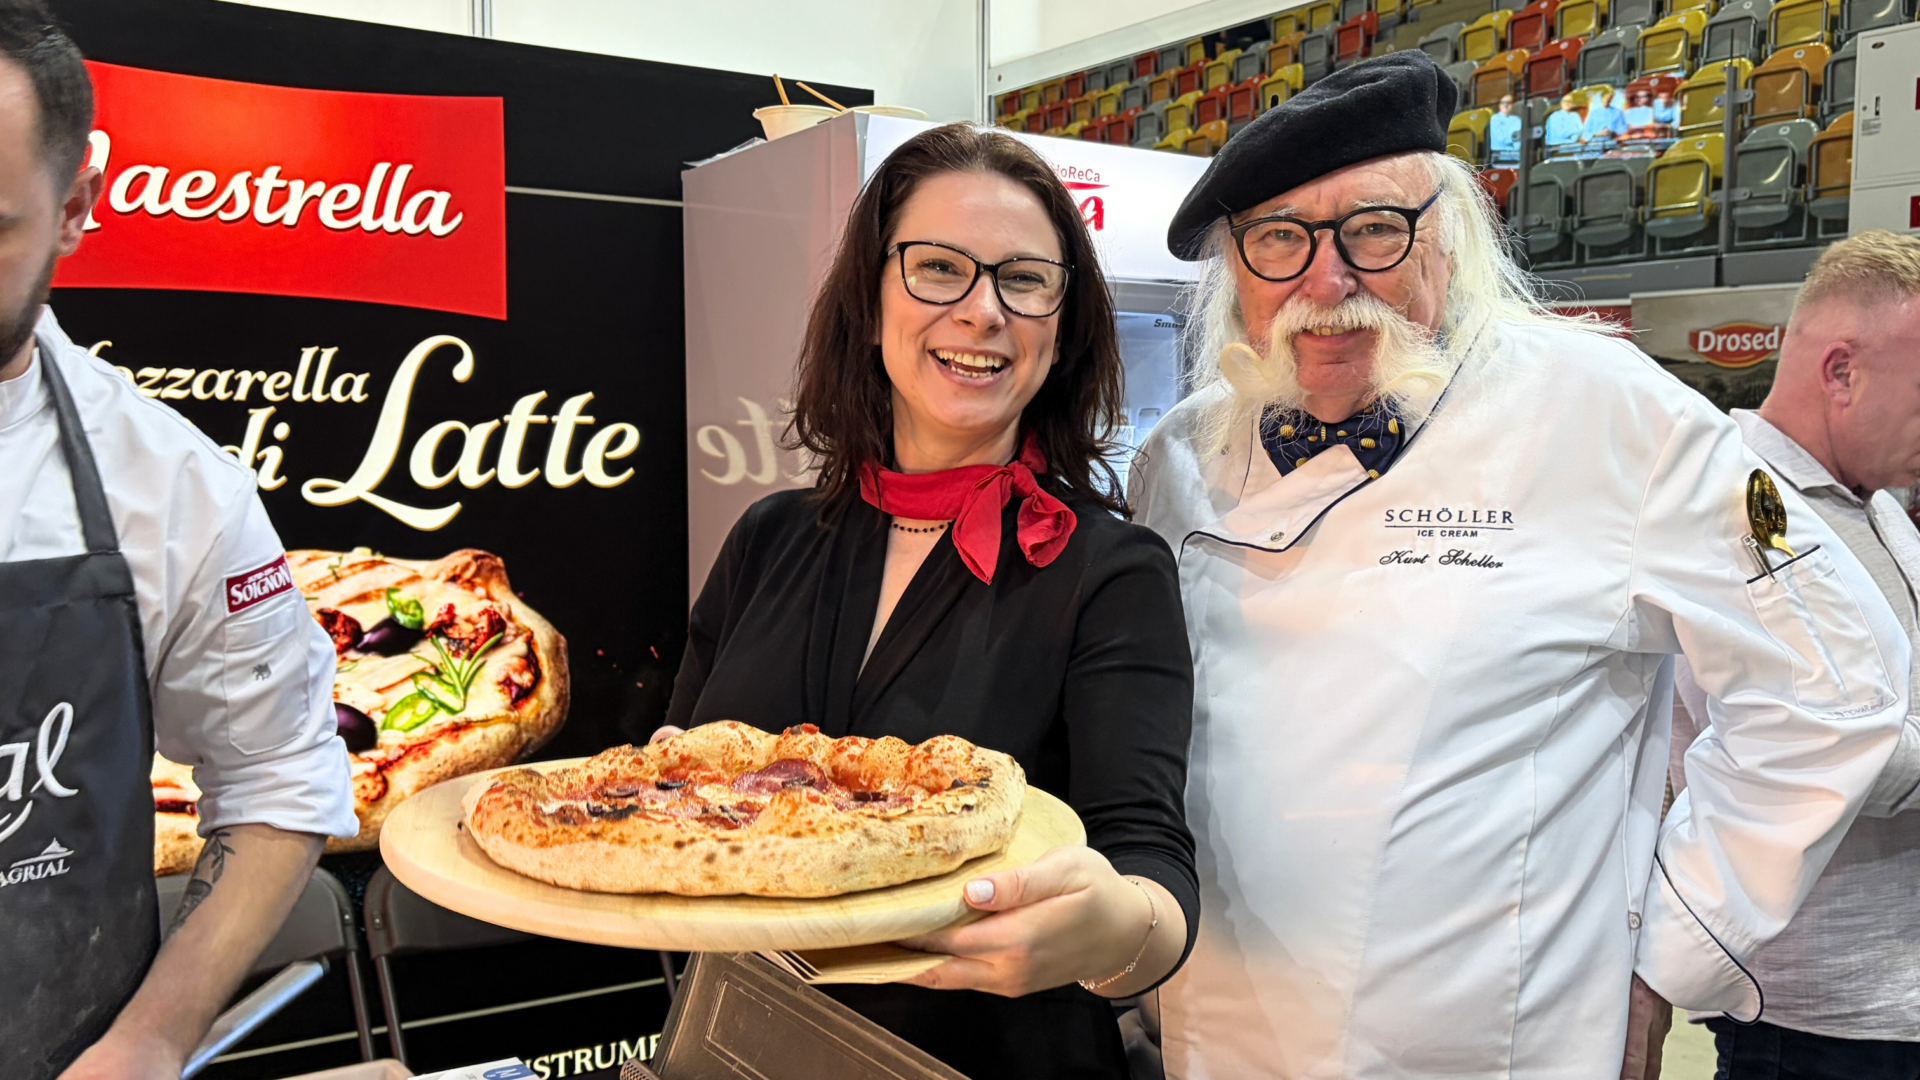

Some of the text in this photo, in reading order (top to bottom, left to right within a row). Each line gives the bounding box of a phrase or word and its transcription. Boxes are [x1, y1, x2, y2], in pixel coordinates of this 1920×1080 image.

[1697, 325, 1780, 353] Drosed
[301, 334, 641, 532] Latte
[1384, 507, 1514, 524] SCHÖLLER
[1417, 529, 1478, 538] ICE CREAM
[1379, 548, 1503, 569] Kurt Scheller
